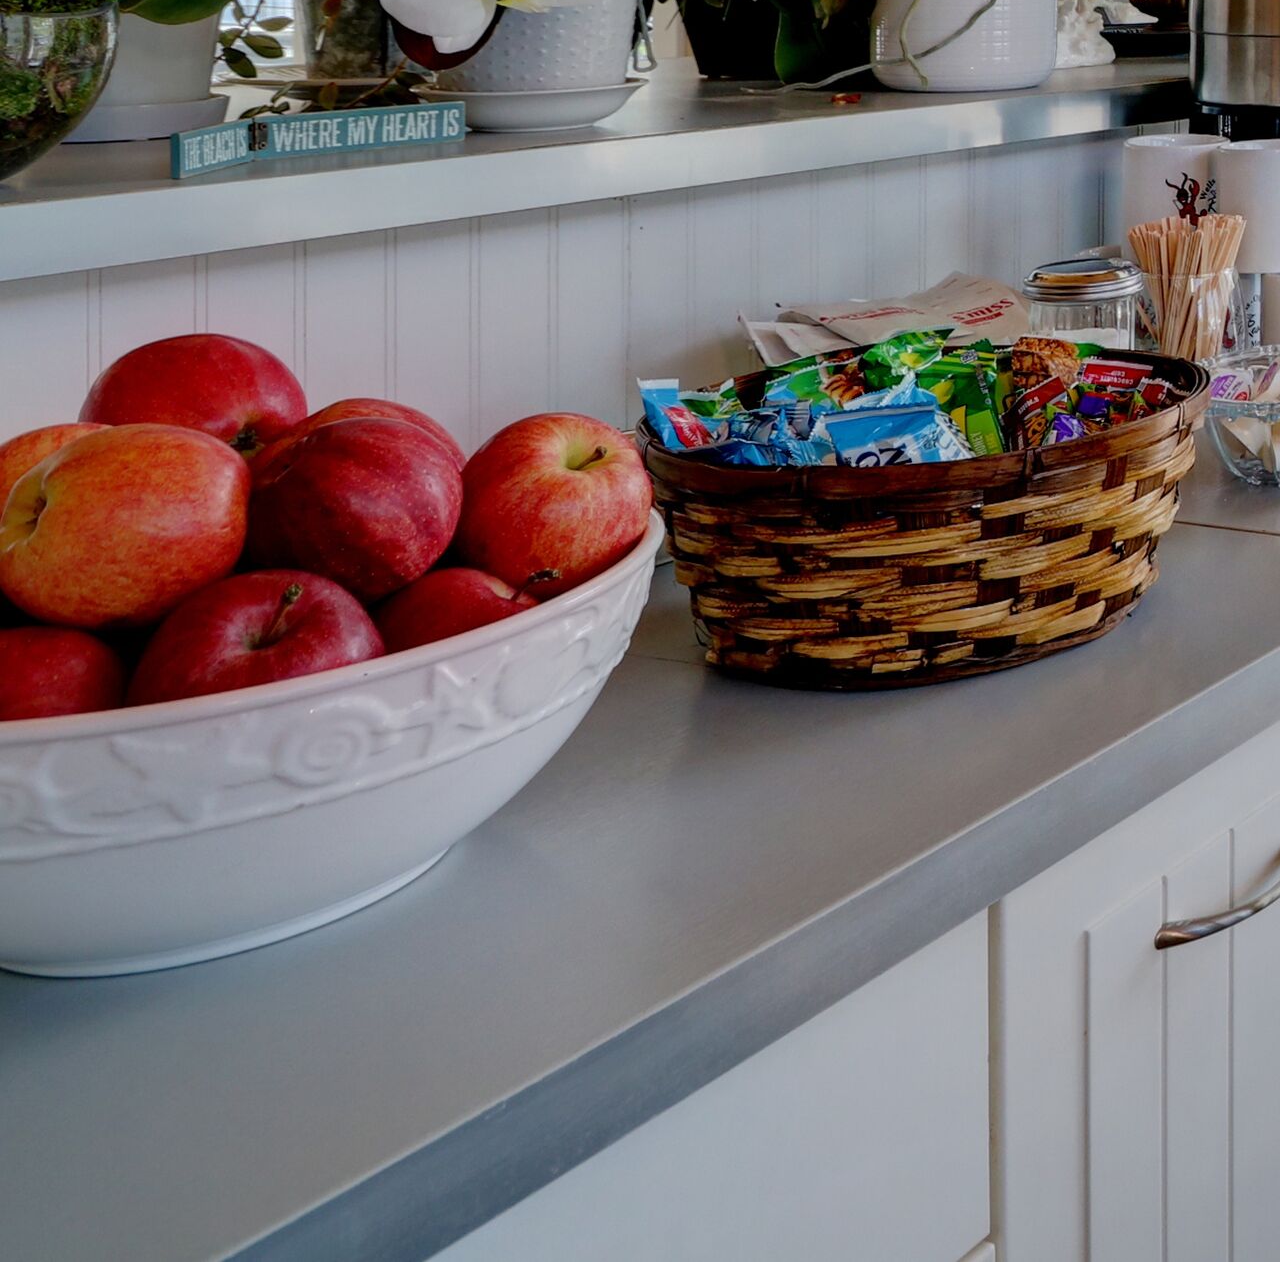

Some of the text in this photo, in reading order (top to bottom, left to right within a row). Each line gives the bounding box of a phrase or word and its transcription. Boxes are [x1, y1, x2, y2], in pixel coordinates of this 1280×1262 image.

[183, 127, 247, 172] THE BEACH IS
[272, 108, 460, 153] WHERE MY HEART IS
